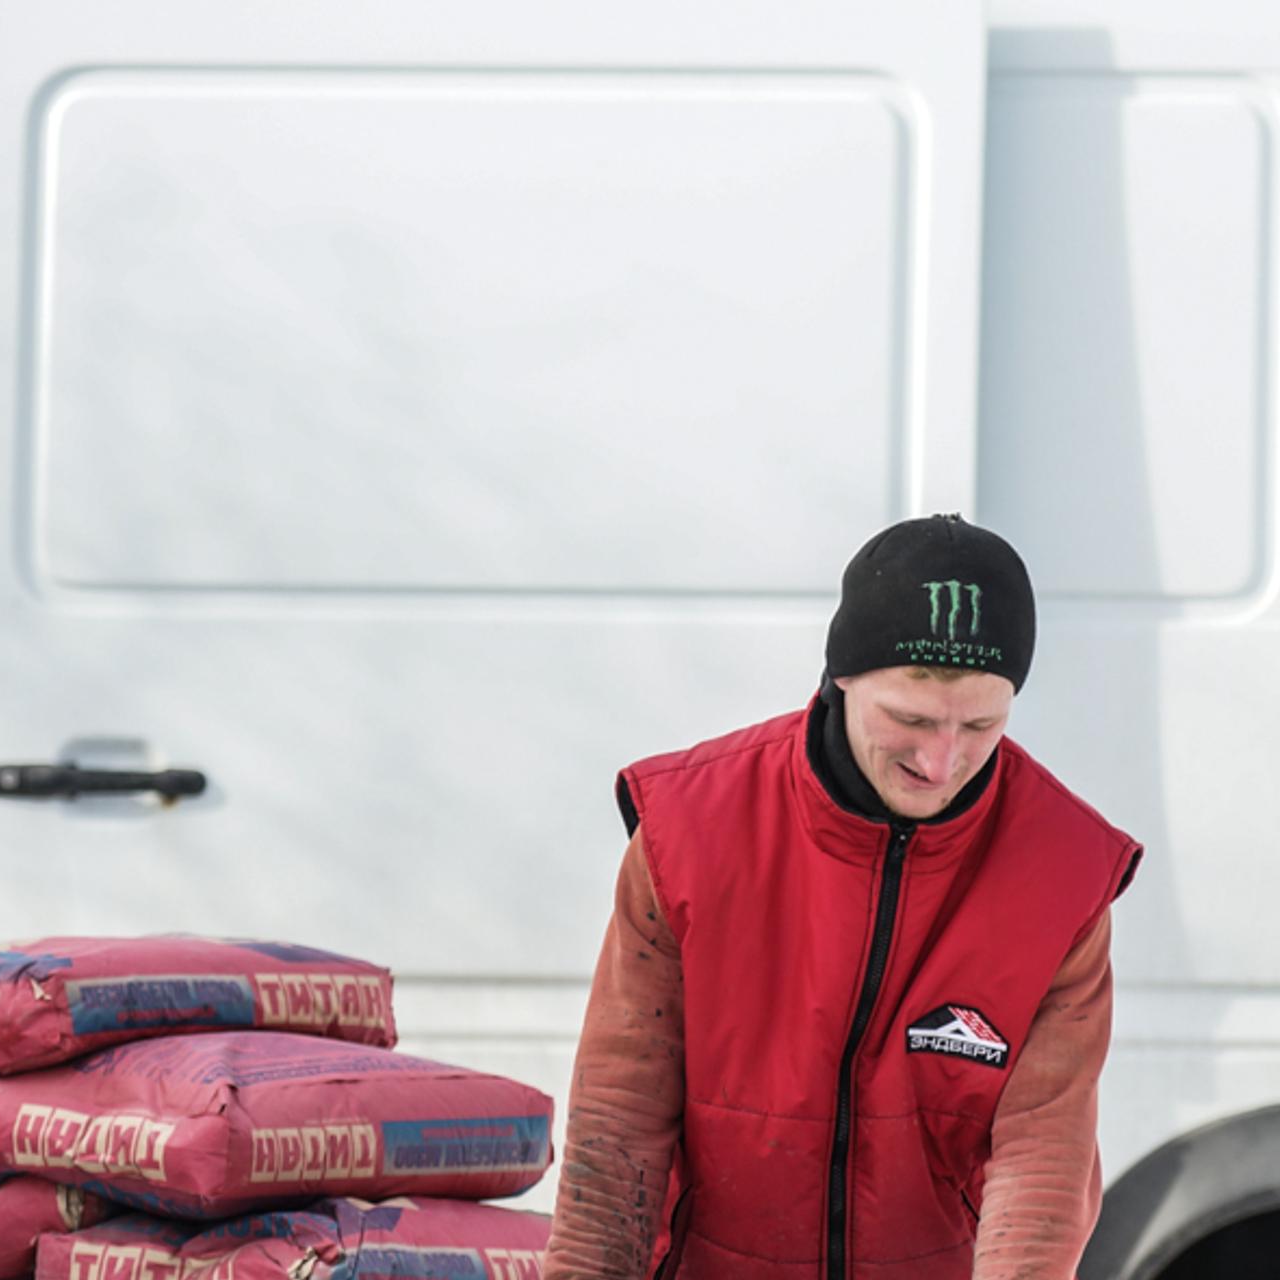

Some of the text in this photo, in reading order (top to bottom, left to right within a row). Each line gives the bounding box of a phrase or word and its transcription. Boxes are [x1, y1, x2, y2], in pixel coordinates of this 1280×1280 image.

[256, 976, 383, 1029] ТИТАН
[910, 1035, 1002, 1063] ЭНДВЕРИ
[15, 1104, 174, 1180] ТИТАН
[252, 1125, 374, 1182] ТИТАН
